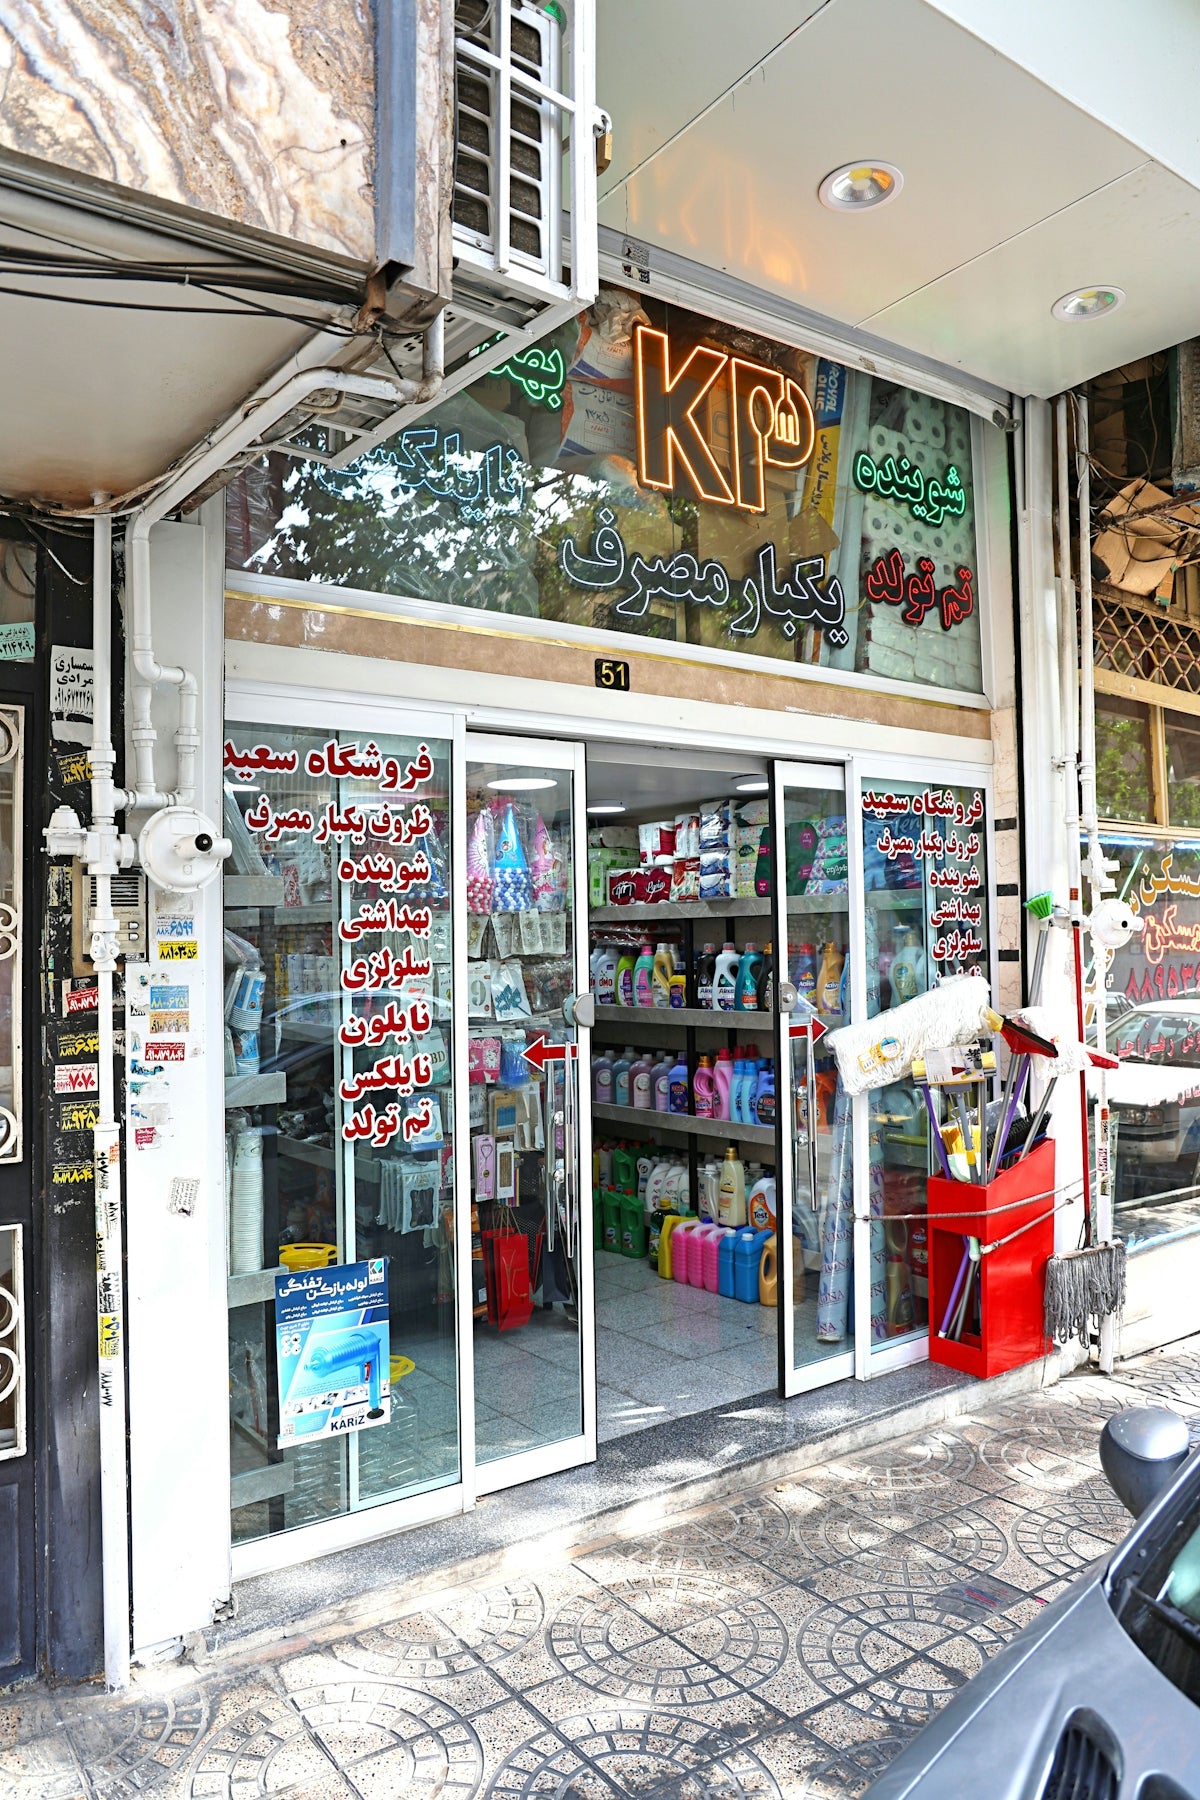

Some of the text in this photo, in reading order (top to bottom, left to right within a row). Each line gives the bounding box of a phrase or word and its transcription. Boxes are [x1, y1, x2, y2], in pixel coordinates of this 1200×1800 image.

[636, 325, 815, 512] KP
[855, 453, 966, 523] شوینده
[562, 507, 849, 645] یکبار مصرف
[866, 552, 936, 623] تولد
[601, 663, 627, 687] 51
[224, 741, 432, 790] فروشگاه سعید
[247, 797, 431, 844] ظروف یکبار مصرف
[862, 791, 983, 825] فروشگاه سعید
[878, 829, 979, 861] ظروف یکبار مصرف
[340, 853, 429, 891] شوینده
[930, 868, 979, 893] شوینده
[1140, 853, 1200, 907] سکن
[341, 901, 430, 940] بهداشتی
[930, 899, 980, 927] بهداشتی
[932, 931, 982, 959] سلولزی
[343, 949, 431, 988] سلولزی
[340, 1002, 431, 1043] نایلون
[341, 1055, 431, 1098] نایلکس
[344, 1101, 431, 1145] تم تولد
[279, 1276, 323, 1297] تفنگی
[306, 1281, 346, 1301] بازکن
[331, 1415, 366, 1431] KARiZ
